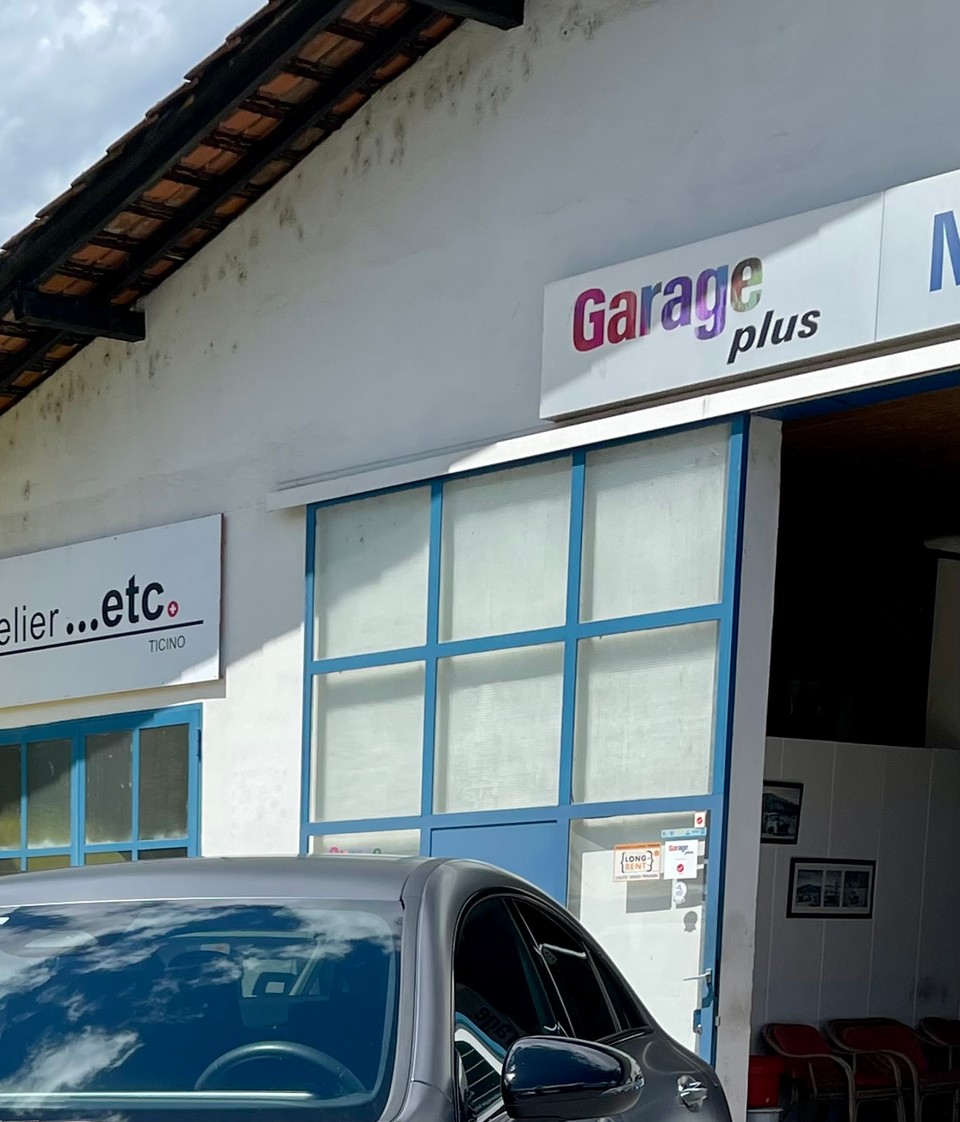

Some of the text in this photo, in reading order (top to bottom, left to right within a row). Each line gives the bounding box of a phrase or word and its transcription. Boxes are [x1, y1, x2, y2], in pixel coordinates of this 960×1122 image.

[572, 256, 764, 353] Garage
[726, 309, 821, 365] plus
[148, 635, 186, 653] TICINO
[625, 855, 647, 863] LONG
[625, 862, 647, 871] RENT
